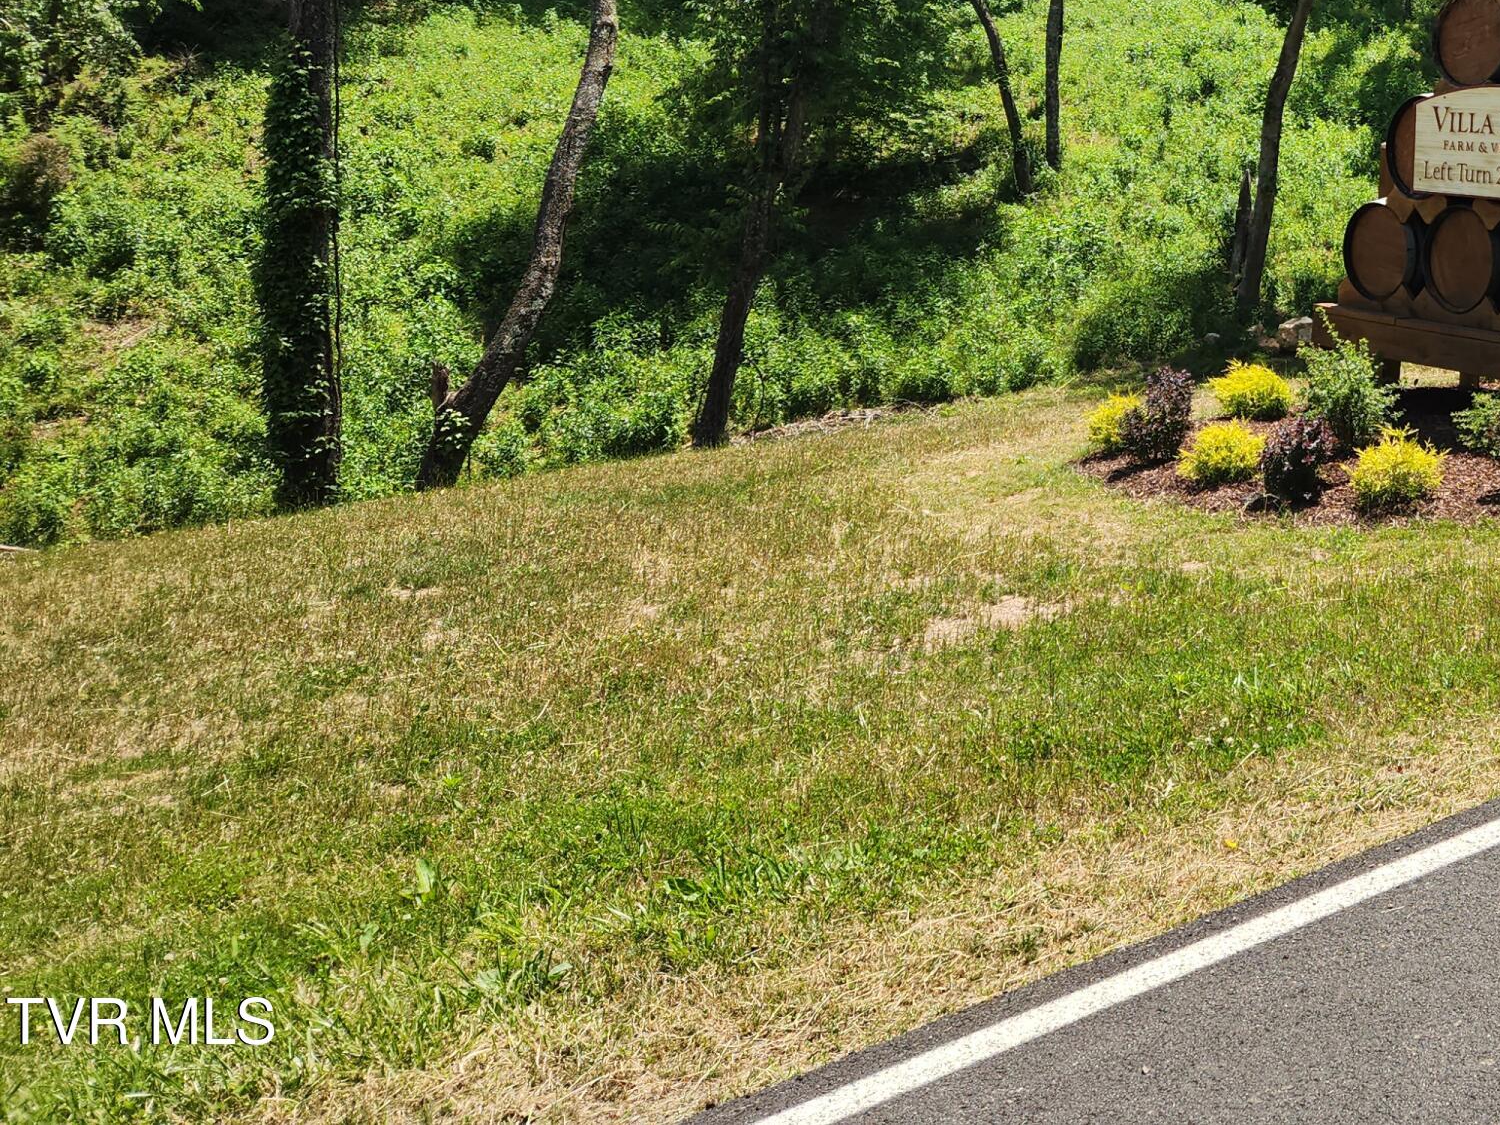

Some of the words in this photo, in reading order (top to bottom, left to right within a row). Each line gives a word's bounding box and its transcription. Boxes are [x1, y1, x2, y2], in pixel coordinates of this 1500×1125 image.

[1432, 106, 1495, 135] VILLA
[1443, 140, 1474, 152] FARM
[1478, 142, 1488, 153] &
[1424, 161, 1453, 181] Left
[1456, 163, 1491, 184] Turn
